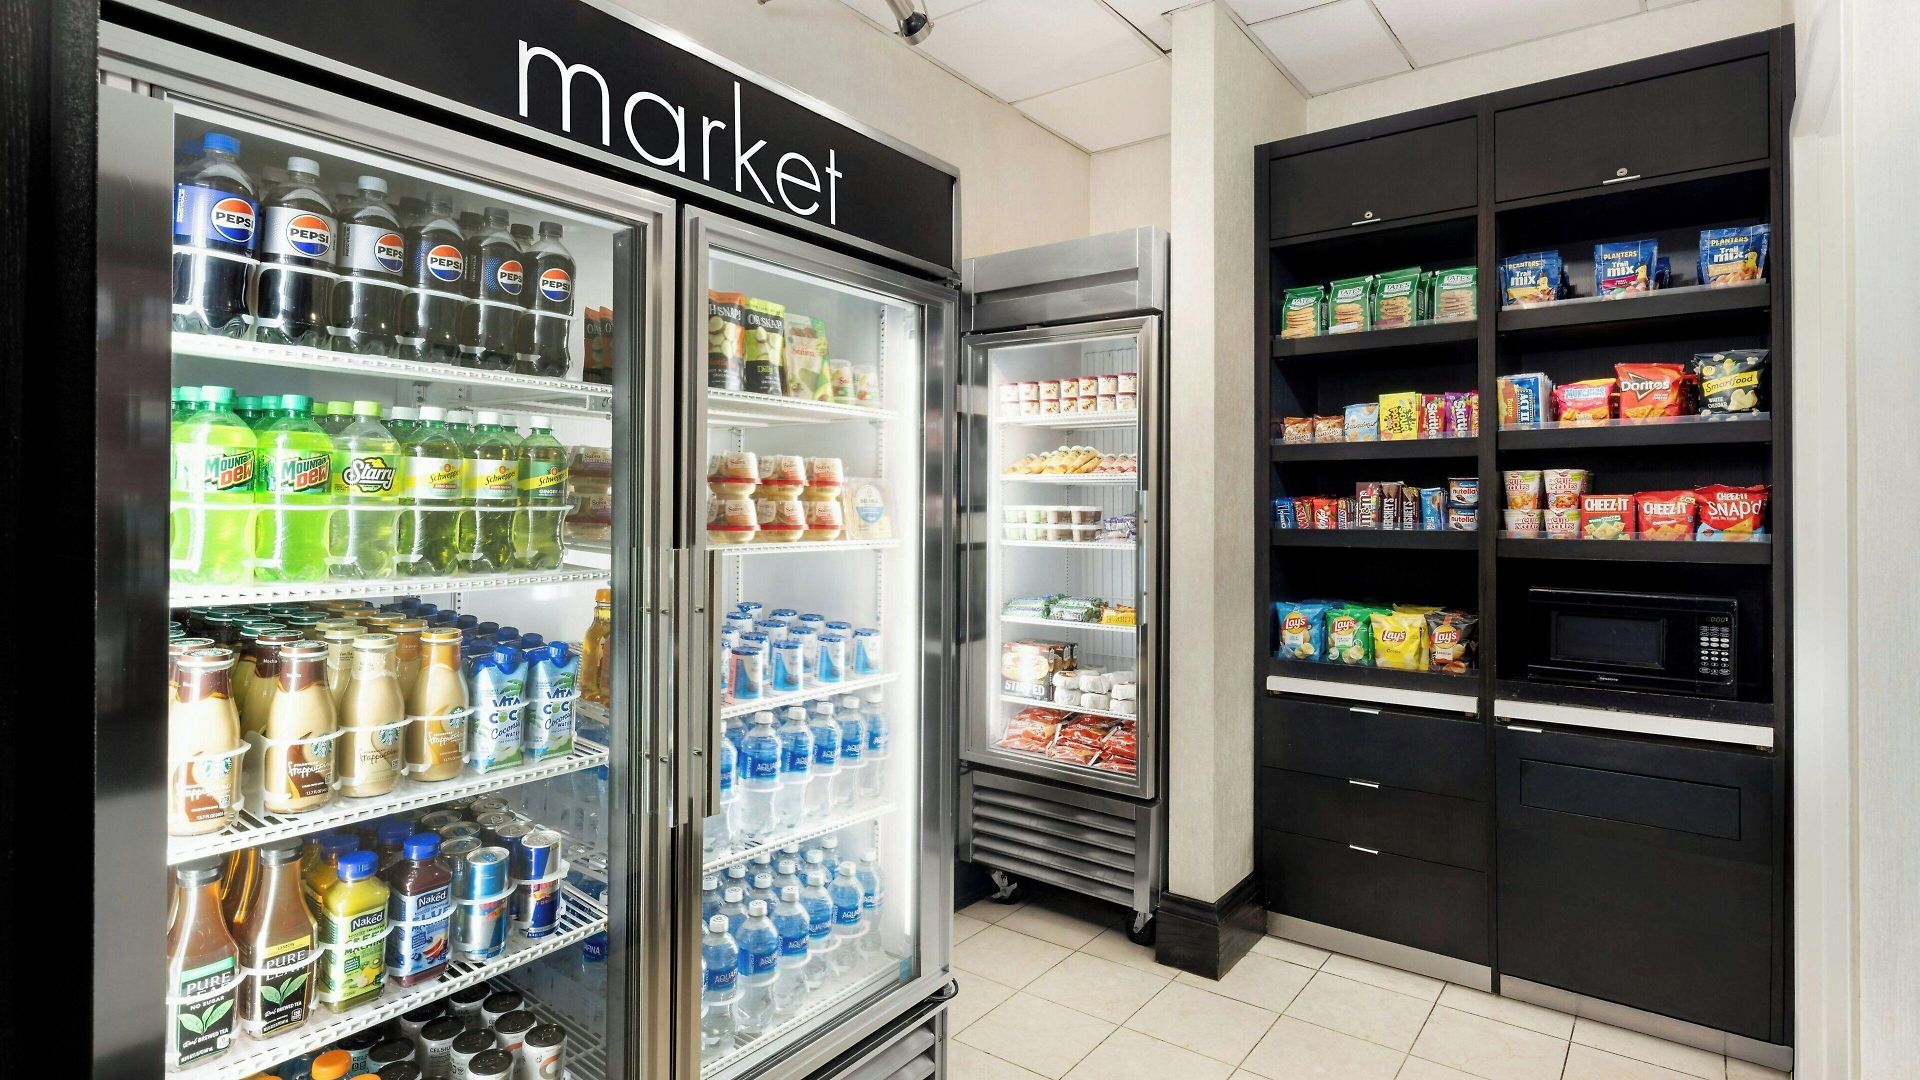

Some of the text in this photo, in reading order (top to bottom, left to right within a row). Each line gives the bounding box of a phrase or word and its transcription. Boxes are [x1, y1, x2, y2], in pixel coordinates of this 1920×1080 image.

[518, 39, 843, 225] market
[290, 228, 330, 244] PEPSI
[1711, 236, 1749, 246] PLANTERS
[377, 246, 403, 259] PEPS
[1603, 250, 1638, 260] PLANTERS
[1713, 251, 1744, 262] mix
[1720, 246, 1740, 255] Trail
[430, 257, 462, 270] PEPSI
[1508, 260, 1540, 270] PLANTERS
[1611, 260, 1629, 269] Trail
[500, 272, 522, 283] PEPS
[1515, 270, 1533, 278] Trail
[1607, 266, 1635, 277] mix
[541, 279, 571, 291] PEPSI
[1510, 275, 1536, 286] mix
[708, 304, 716, 315] H
[1621, 378, 1670, 392] Doritos
[1706, 374, 1754, 393] Smartfood
[1390, 406, 1402, 434] PATCH
[1399, 406, 1410, 432] SOUR
[344, 458, 396, 490] Starry
[485, 471, 516, 485] Schweppe
[1584, 498, 1630, 512] CHEEZ-IT
[1707, 500, 1762, 519] SNAP'd
[1285, 617, 1307, 630] Lay's
[1334, 618, 1356, 631] Lay's
[1383, 630, 1406, 642] Lay's
[1434, 632, 1457, 645] Lay's
[543, 701, 572, 714] COC
[842, 909, 861, 919] AQUA
[266, 949, 307, 969] PURE
[186, 971, 232, 996] PURE
[202, 995, 225, 1007] SUGAR
[219, 1027, 229, 1035] TEA
